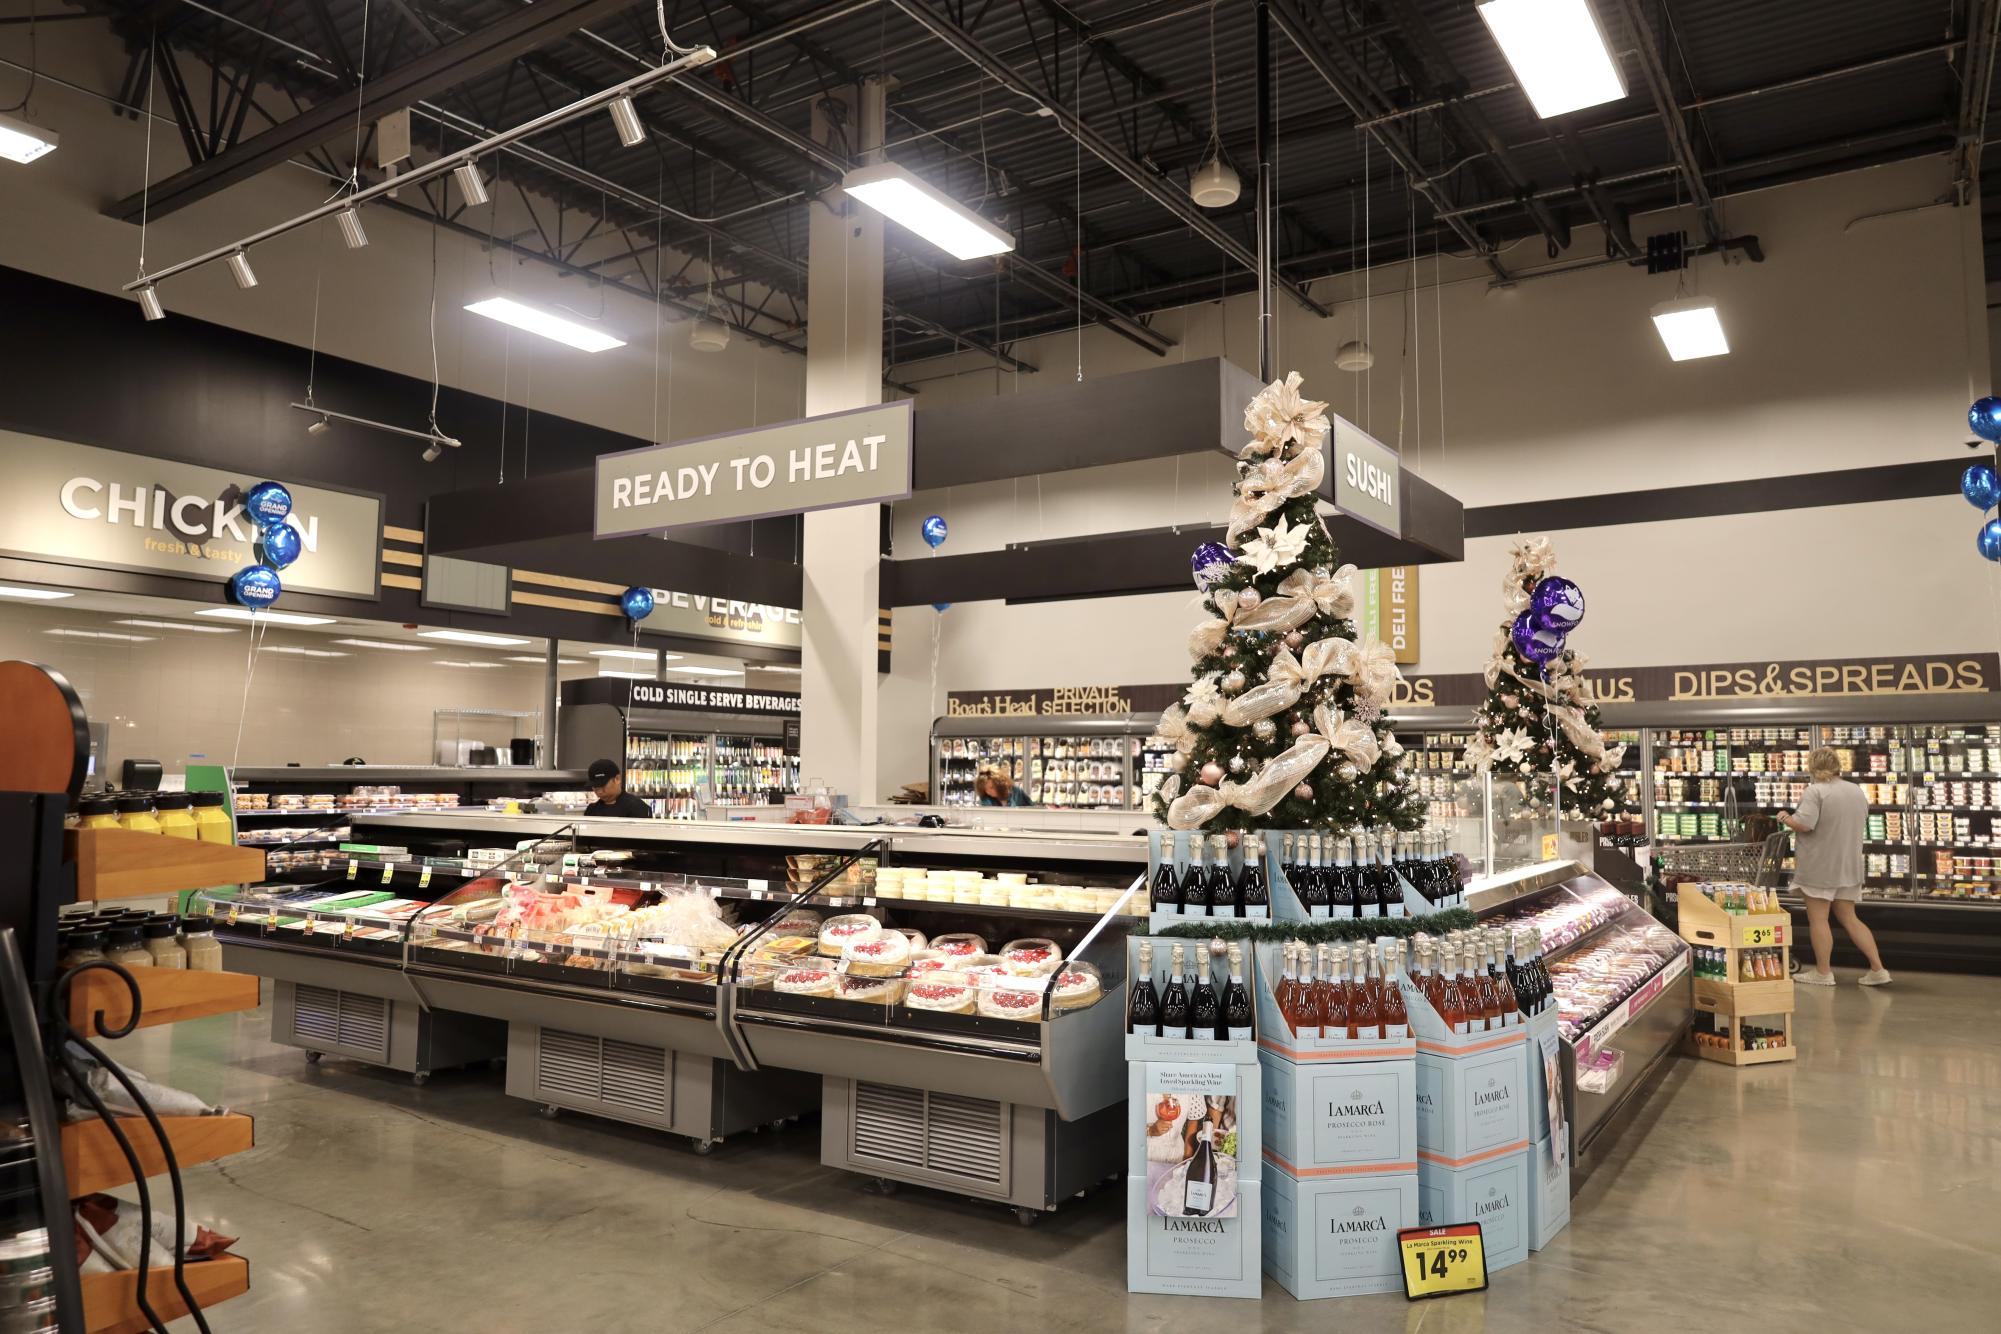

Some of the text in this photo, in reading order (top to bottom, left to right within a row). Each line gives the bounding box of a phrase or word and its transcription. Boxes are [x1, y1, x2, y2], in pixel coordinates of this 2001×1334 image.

[613, 434, 886, 509] READY TO HEAT
[1347, 452, 1391, 506] SUSHI
[260, 501, 287, 511] GRAND
[143, 537, 242, 563] fresh & tasty
[244, 585, 274, 595] GRAND
[652, 588, 802, 624] BEVERAGE
[1392, 608, 1406, 650] DELI
[633, 686, 801, 711] COLD SINGLE SERVE BEVERAGES
[1054, 685, 1119, 700] PRIVATE
[949, 694, 1036, 715] Boar's Head
[1041, 699, 1131, 715] SELECTION
[1753, 929, 1761, 943] 3
[1327, 1121, 1366, 1129] PROSECCO
[1429, 1228, 1446, 1236] SALE
[1173, 1236, 1216, 1245] PROSECCO
[1339, 1237, 1379, 1246] PROSECCO
